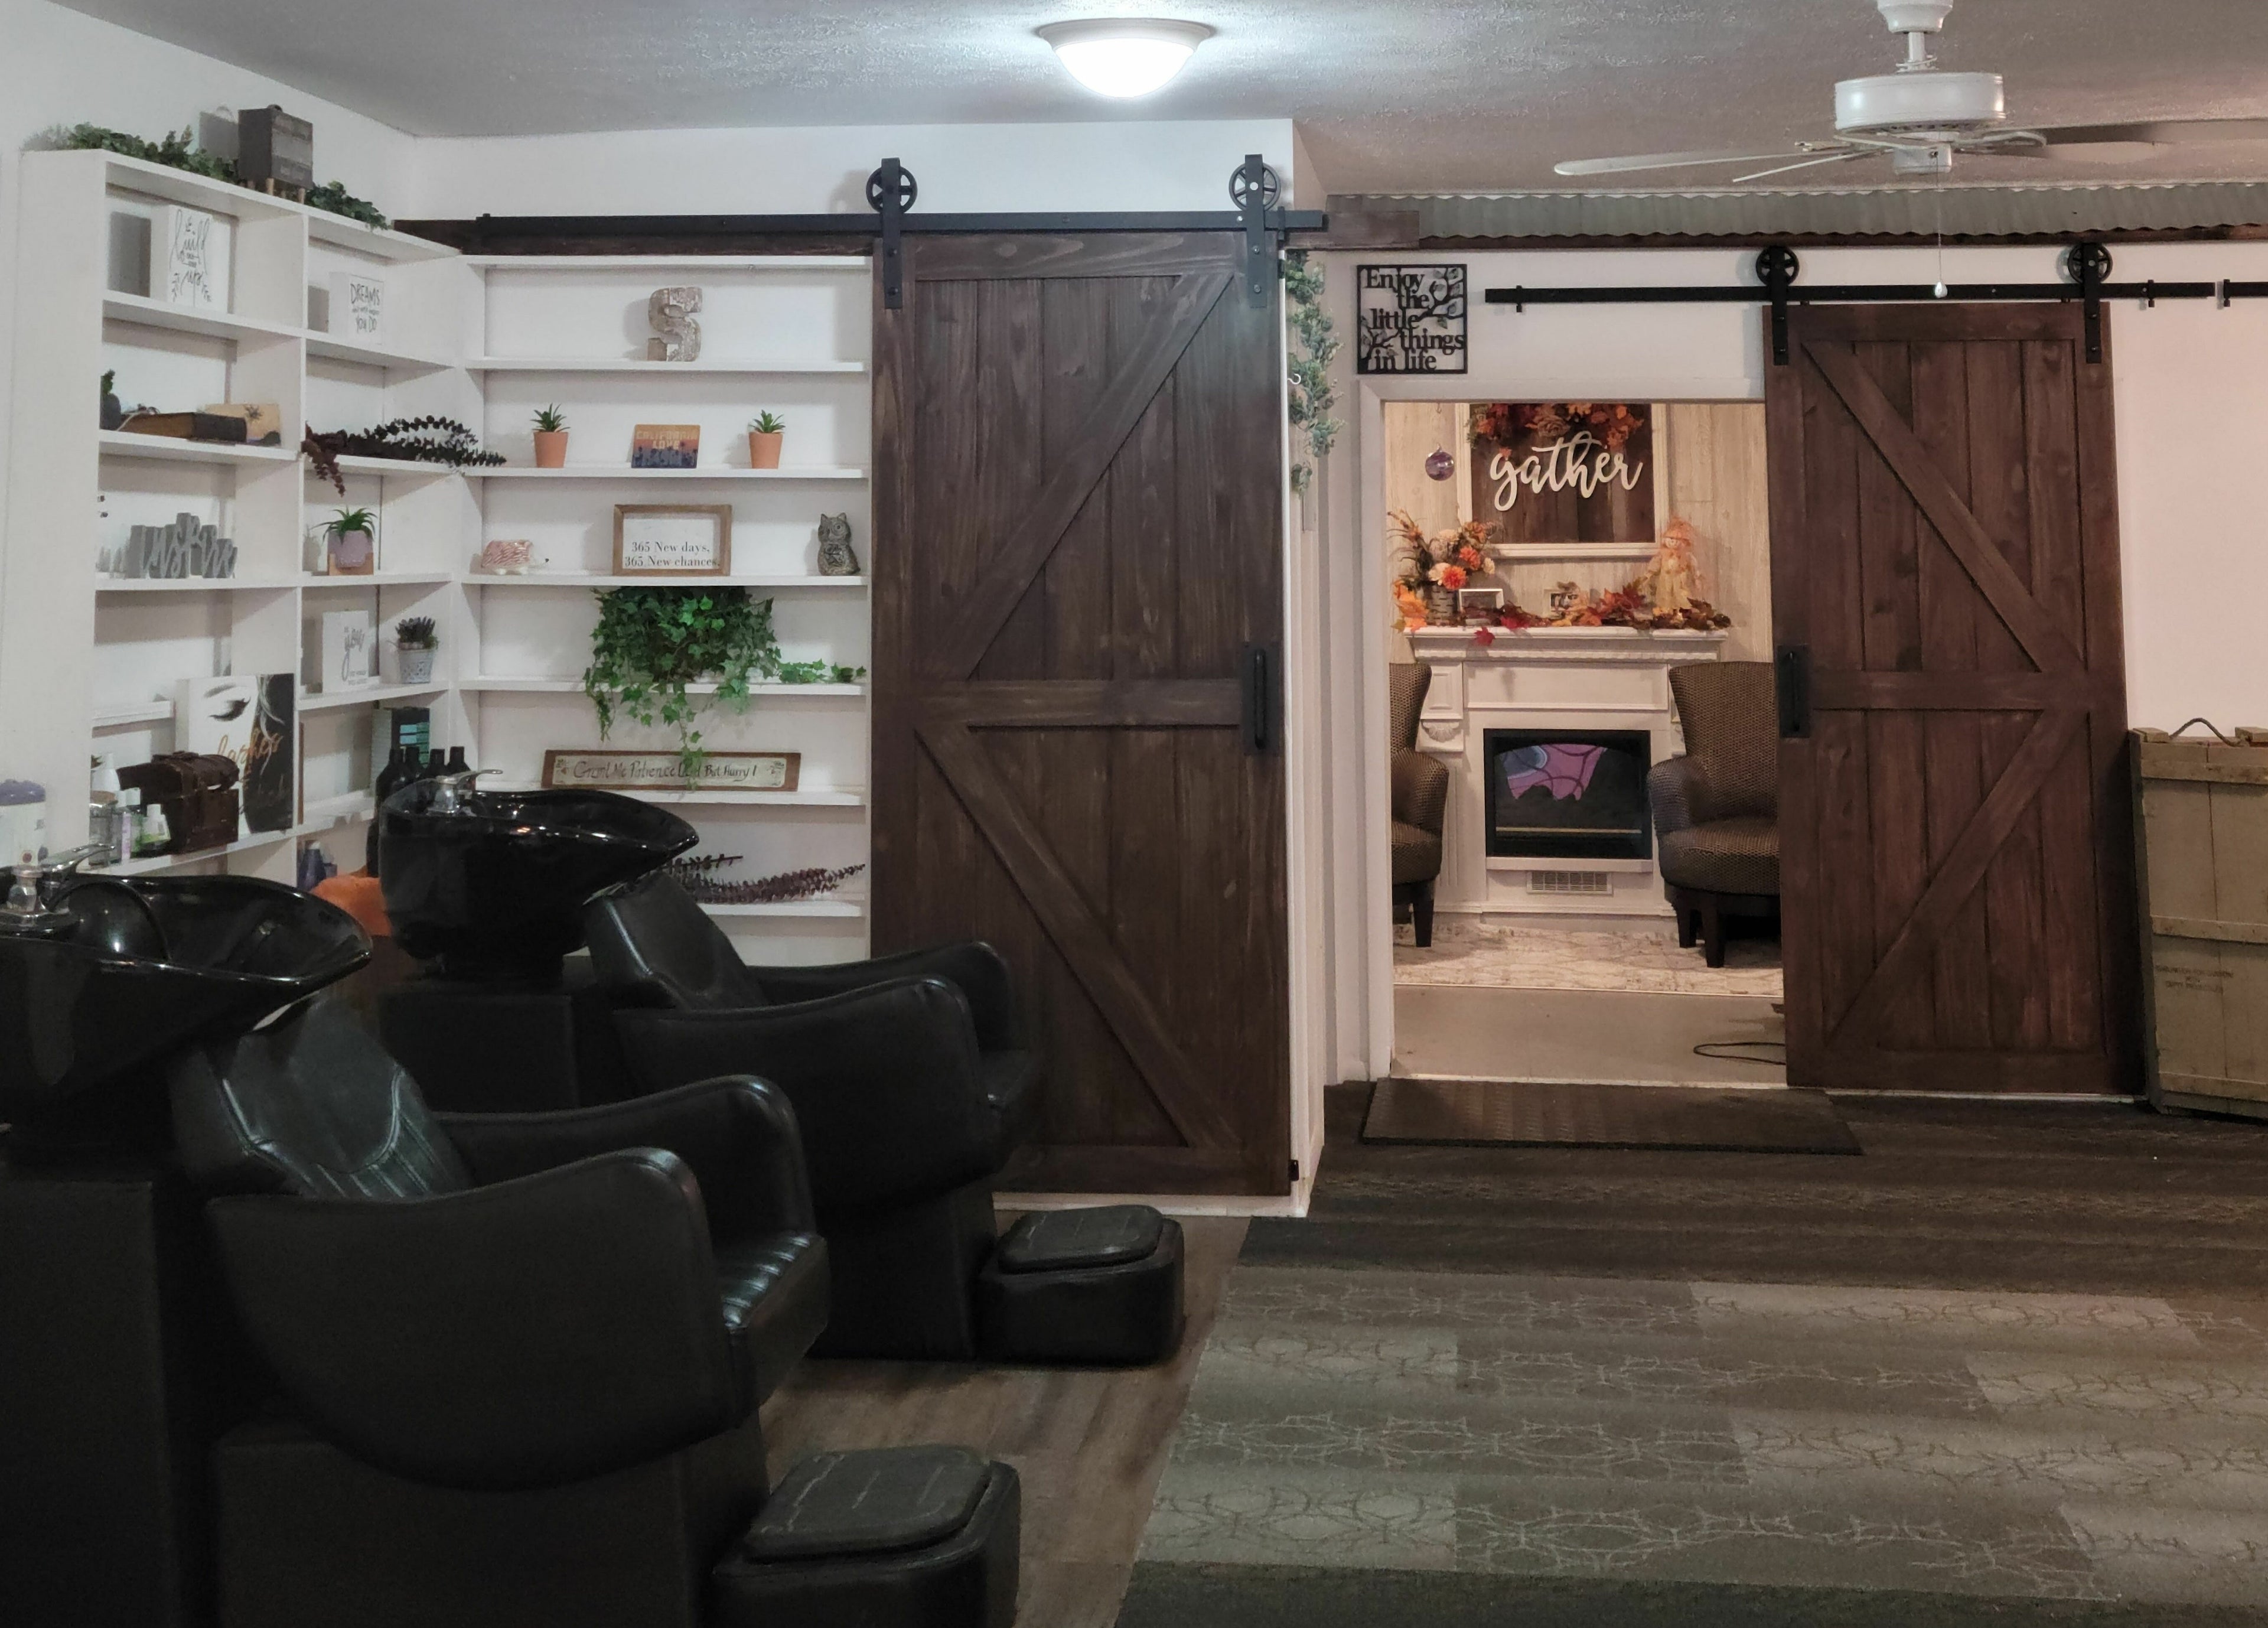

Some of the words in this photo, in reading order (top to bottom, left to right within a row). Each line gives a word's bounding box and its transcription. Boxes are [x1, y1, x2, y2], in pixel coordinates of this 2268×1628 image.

[1365, 268, 1425, 294] Enjoy
[350, 284, 380, 305] DREAMS
[1396, 287, 1430, 309] the
[648, 287, 702, 362] S
[1370, 308, 1420, 330] little
[1400, 327, 1465, 355] things
[1374, 349, 1397, 370] in
[1403, 349, 1437, 371] life
[653, 439, 680, 450] LOVE
[1490, 431, 1643, 512] gather
[632, 541, 650, 552] 365
[655, 542, 677, 552] New
[625, 556, 643, 567] 365
[648, 556, 673, 566] New
[674, 556, 721, 567] chances.
[573, 761, 610, 779] Grant
[612, 762, 627, 778] Me
[630, 760, 676, 778] Patience
[705, 764, 721, 777] But
